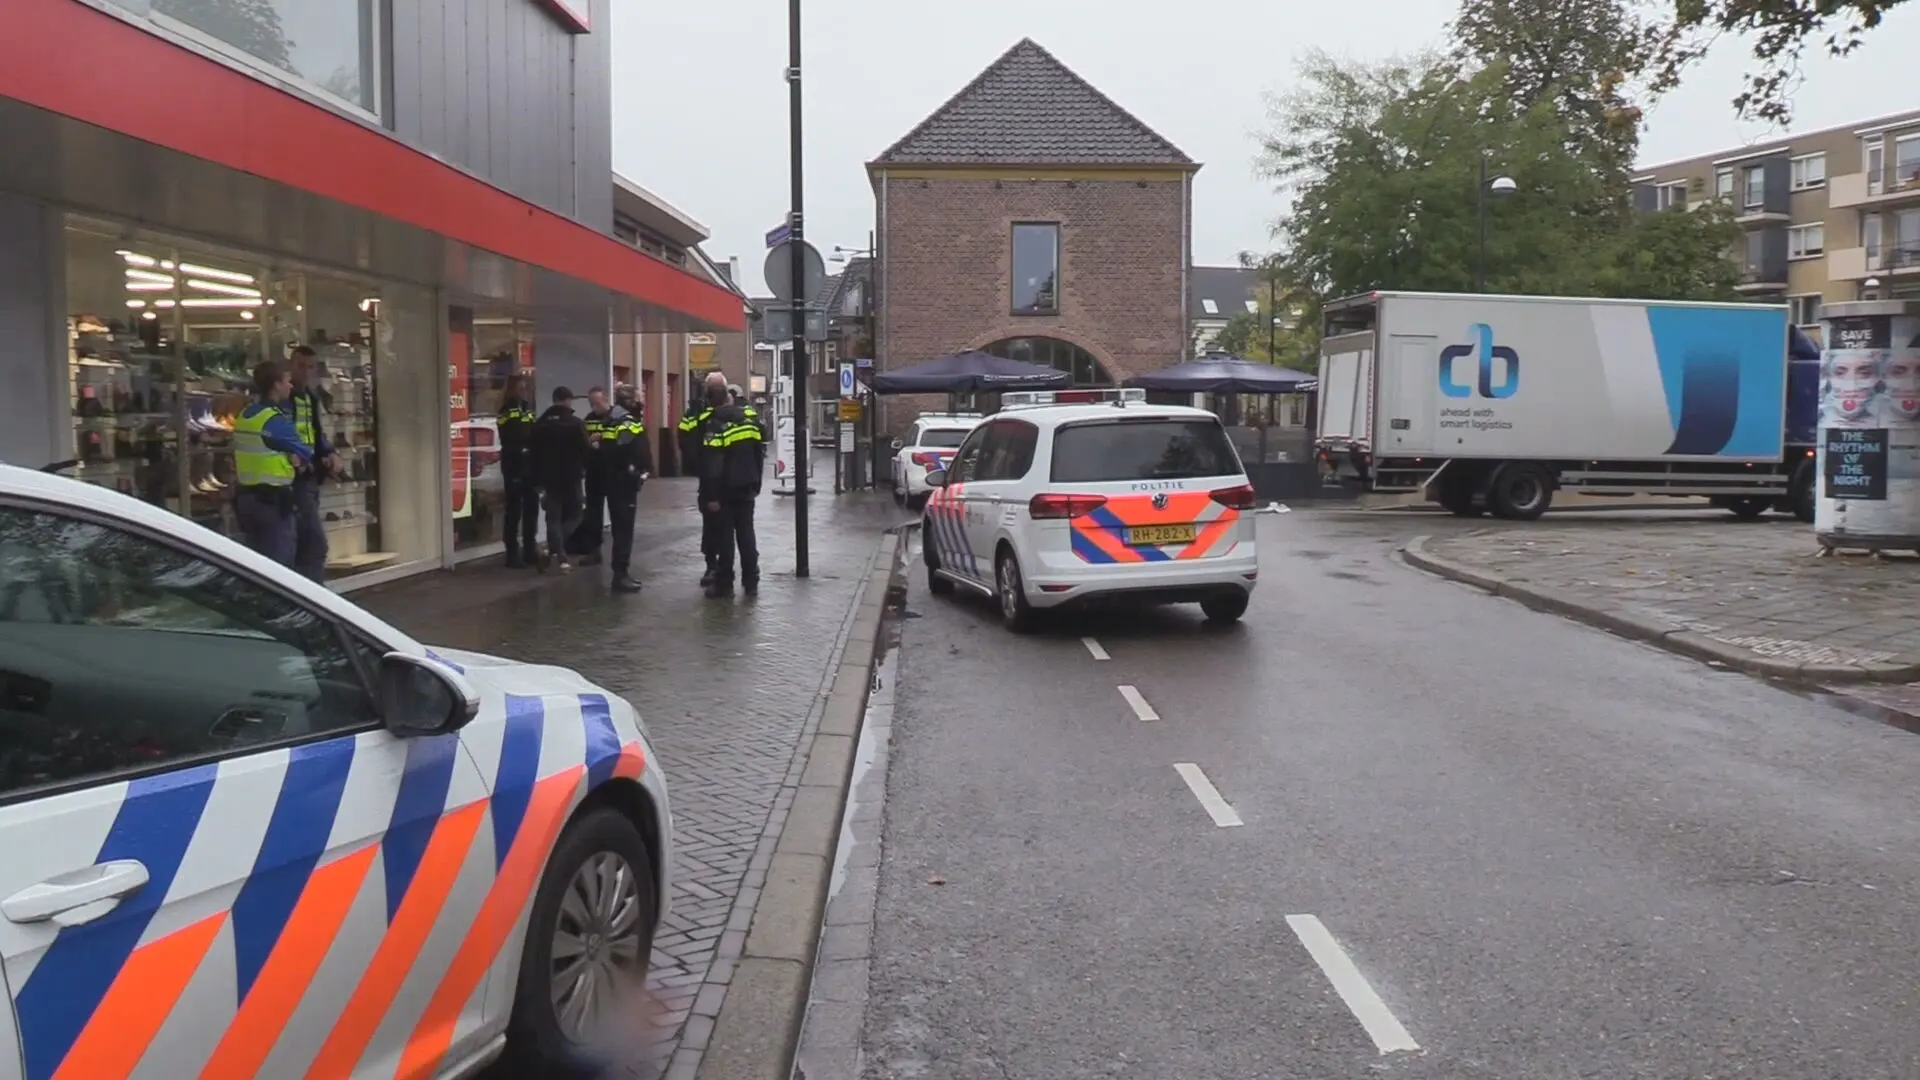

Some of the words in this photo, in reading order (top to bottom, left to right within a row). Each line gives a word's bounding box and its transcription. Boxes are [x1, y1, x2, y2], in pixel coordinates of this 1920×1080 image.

[1841, 329, 1873, 341] SAVE
[1440, 408, 1470, 417] ahead
[1473, 408, 1494, 417] with
[1440, 420, 1469, 428] smart
[1471, 419, 1513, 431] logistics
[1841, 431, 1864, 441] THE
[1828, 442, 1880, 453] RHYTHM
[1844, 453, 1860, 464] OF
[1841, 464, 1864, 475] THE
[1131, 481, 1184, 491] POLITIE
[1833, 475, 1872, 486] NIGHT
